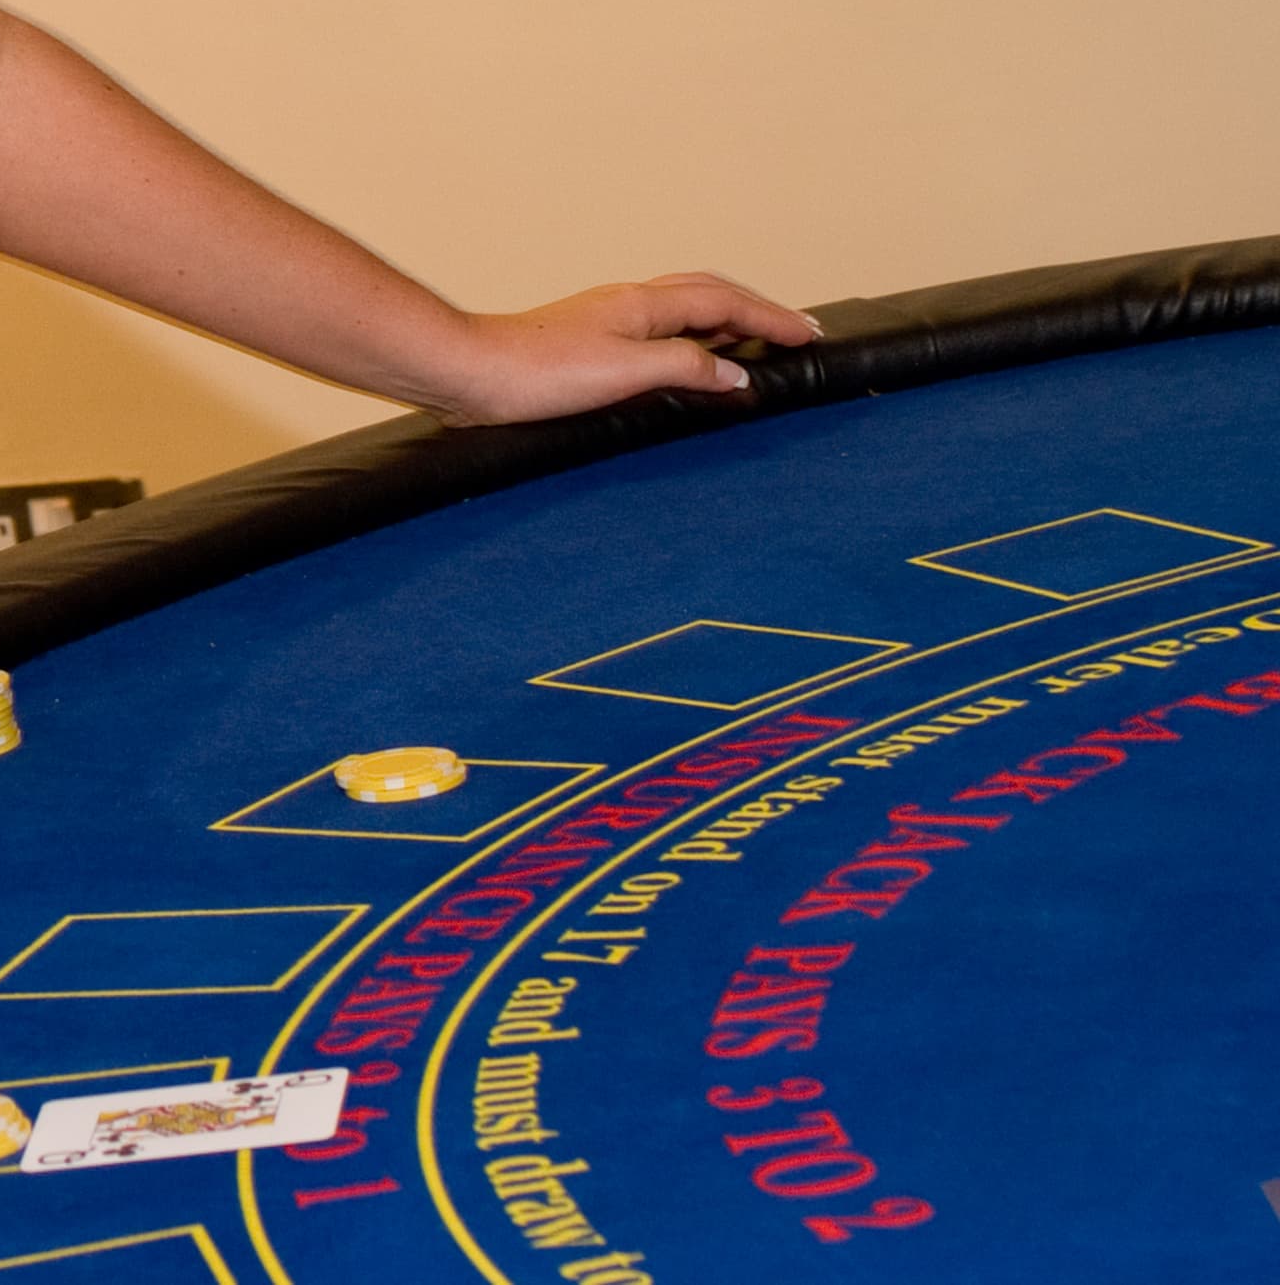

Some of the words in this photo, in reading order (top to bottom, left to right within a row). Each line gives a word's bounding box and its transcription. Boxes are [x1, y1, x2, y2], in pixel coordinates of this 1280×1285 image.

[828, 695, 1030, 770] must
[404, 711, 855, 944] INSURANCE
[658, 774, 844, 862] stand
[587, 871, 683, 917] on
[779, 803, 1012, 924] JACK
[541, 926, 648, 966] 17
[314, 953, 472, 1055] PAYS
[486, 975, 581, 1048] and
[704, 942, 856, 1059] PAYS
[472, 1051, 559, 1152] must
[706, 1076, 825, 1111] 3
[294, 1176, 401, 1210] 1
[724, 1110, 878, 1199] TO
[483, 1153, 607, 1249] draw
[803, 1196, 935, 1243] 2
